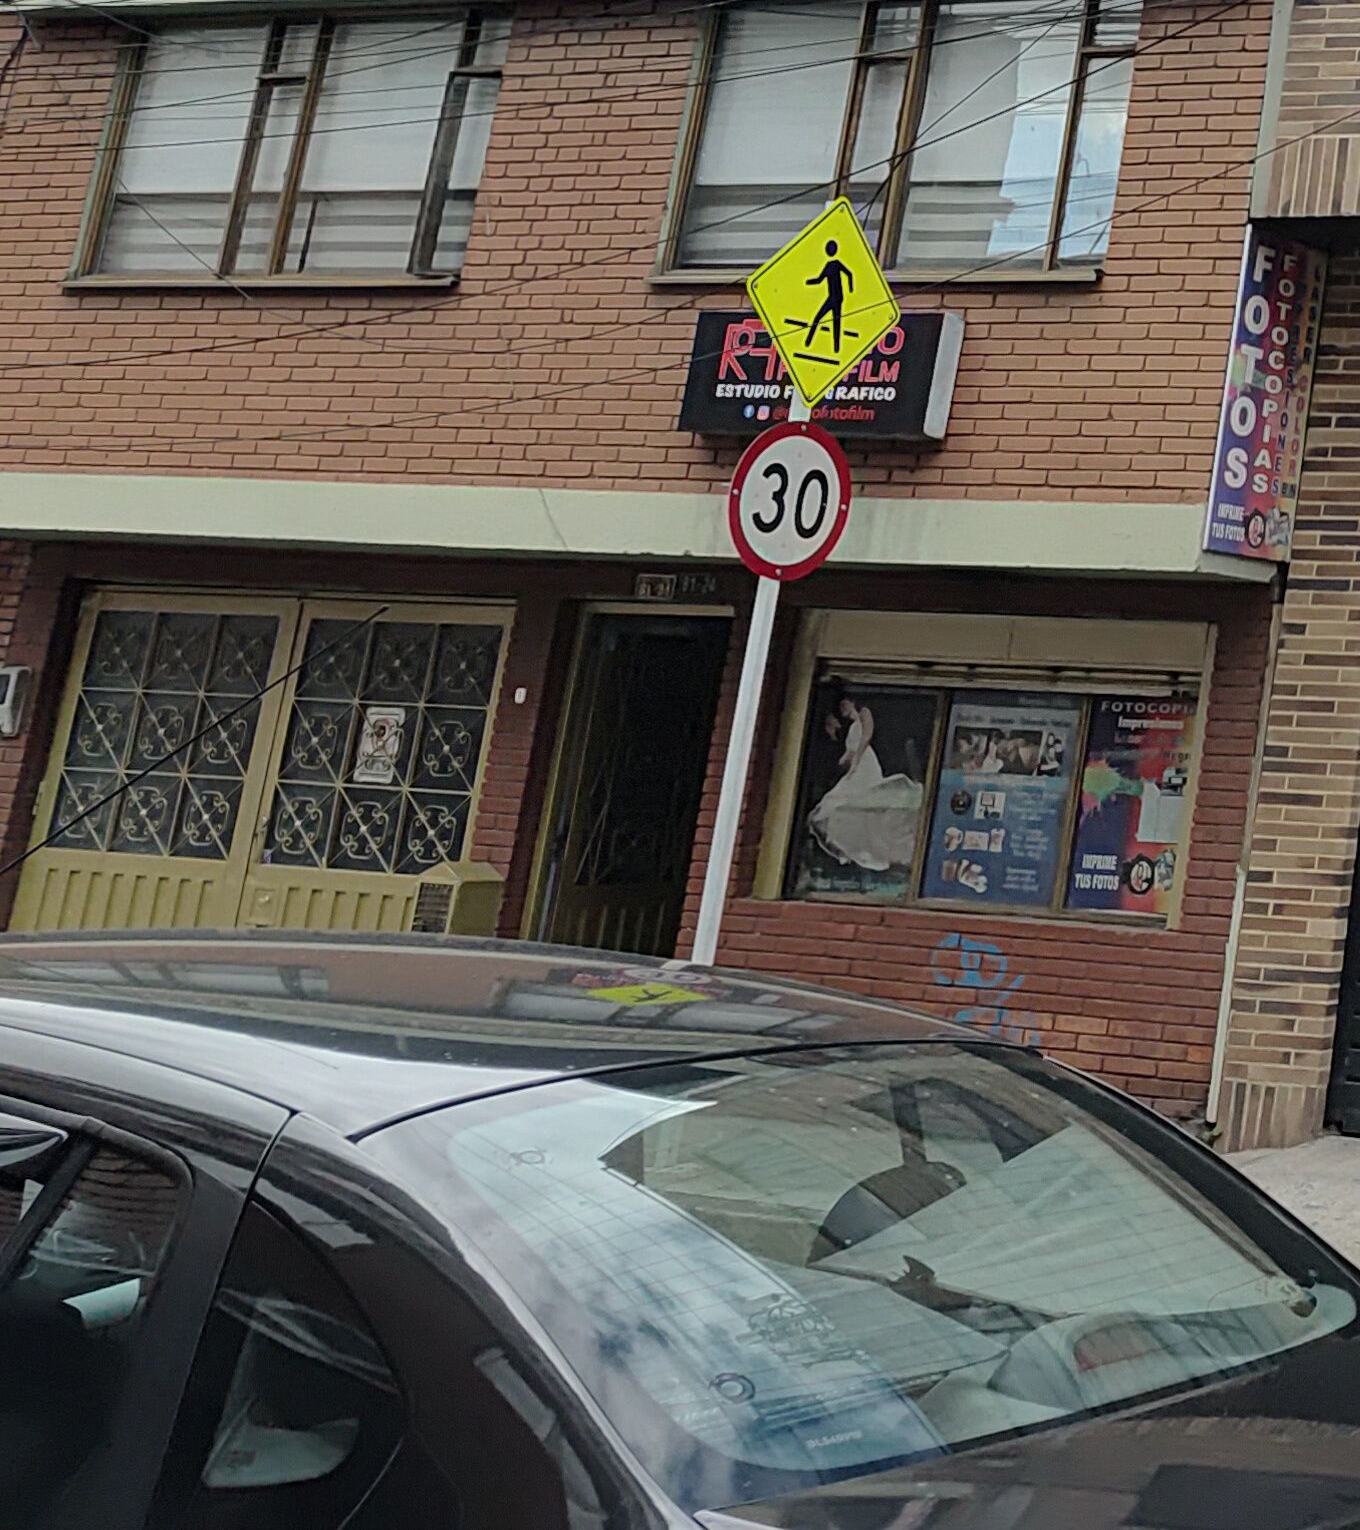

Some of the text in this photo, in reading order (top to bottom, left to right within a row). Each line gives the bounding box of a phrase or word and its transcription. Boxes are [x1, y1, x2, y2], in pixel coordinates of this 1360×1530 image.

[1223, 244, 1274, 490] FOTOS
[1252, 253, 1299, 494] FOTOCOPIAS
[716, 383, 781, 399] ESTUDIO
[751, 462, 830, 539] 30
[1211, 522, 1225, 539] TUS
[1082, 853, 1118, 871] IMPRIME
[1075, 873, 1120, 892] TUS FOTOS
